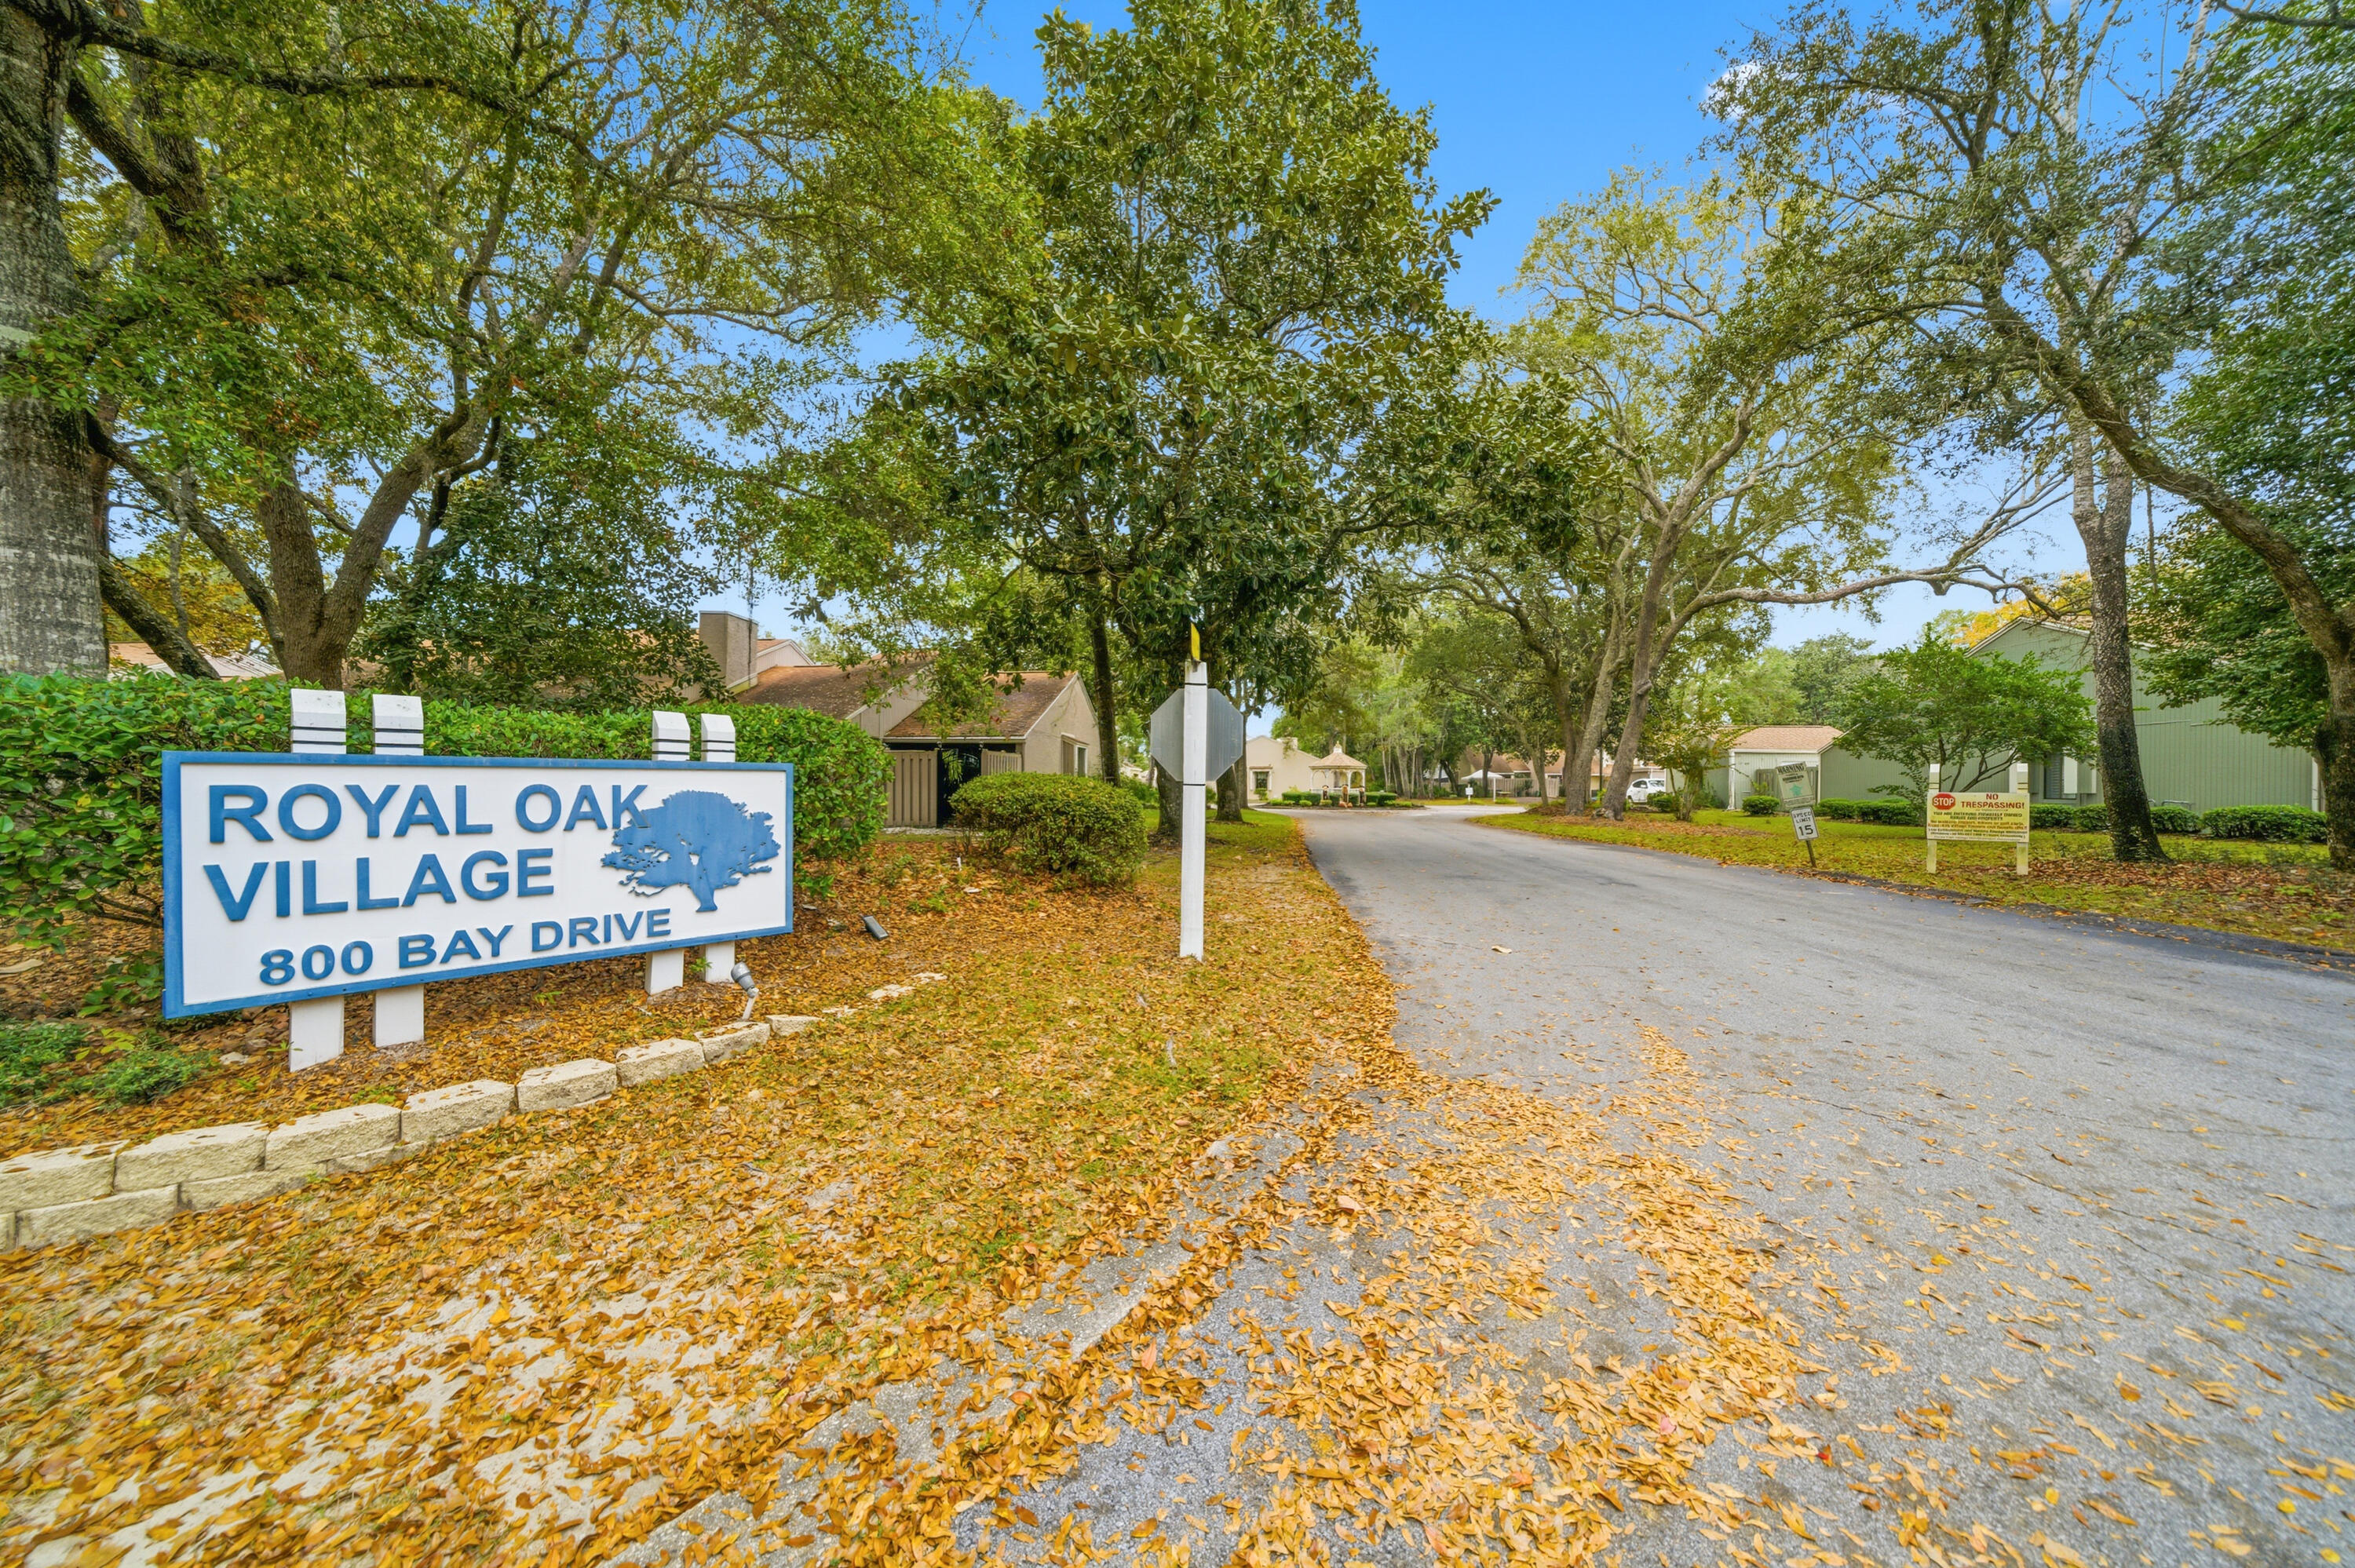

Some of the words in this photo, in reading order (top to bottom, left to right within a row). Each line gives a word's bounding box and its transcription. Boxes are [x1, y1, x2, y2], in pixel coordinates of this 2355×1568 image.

[209, 784, 492, 842] ROYAL
[515, 783, 651, 833] OAK
[1798, 825, 1813, 836] 15
[1933, 797, 1955, 806] STOP
[203, 848, 554, 921] VILLAGE
[260, 941, 374, 986] 800
[399, 925, 514, 970] BAY
[531, 908, 671, 953] DRIVE
